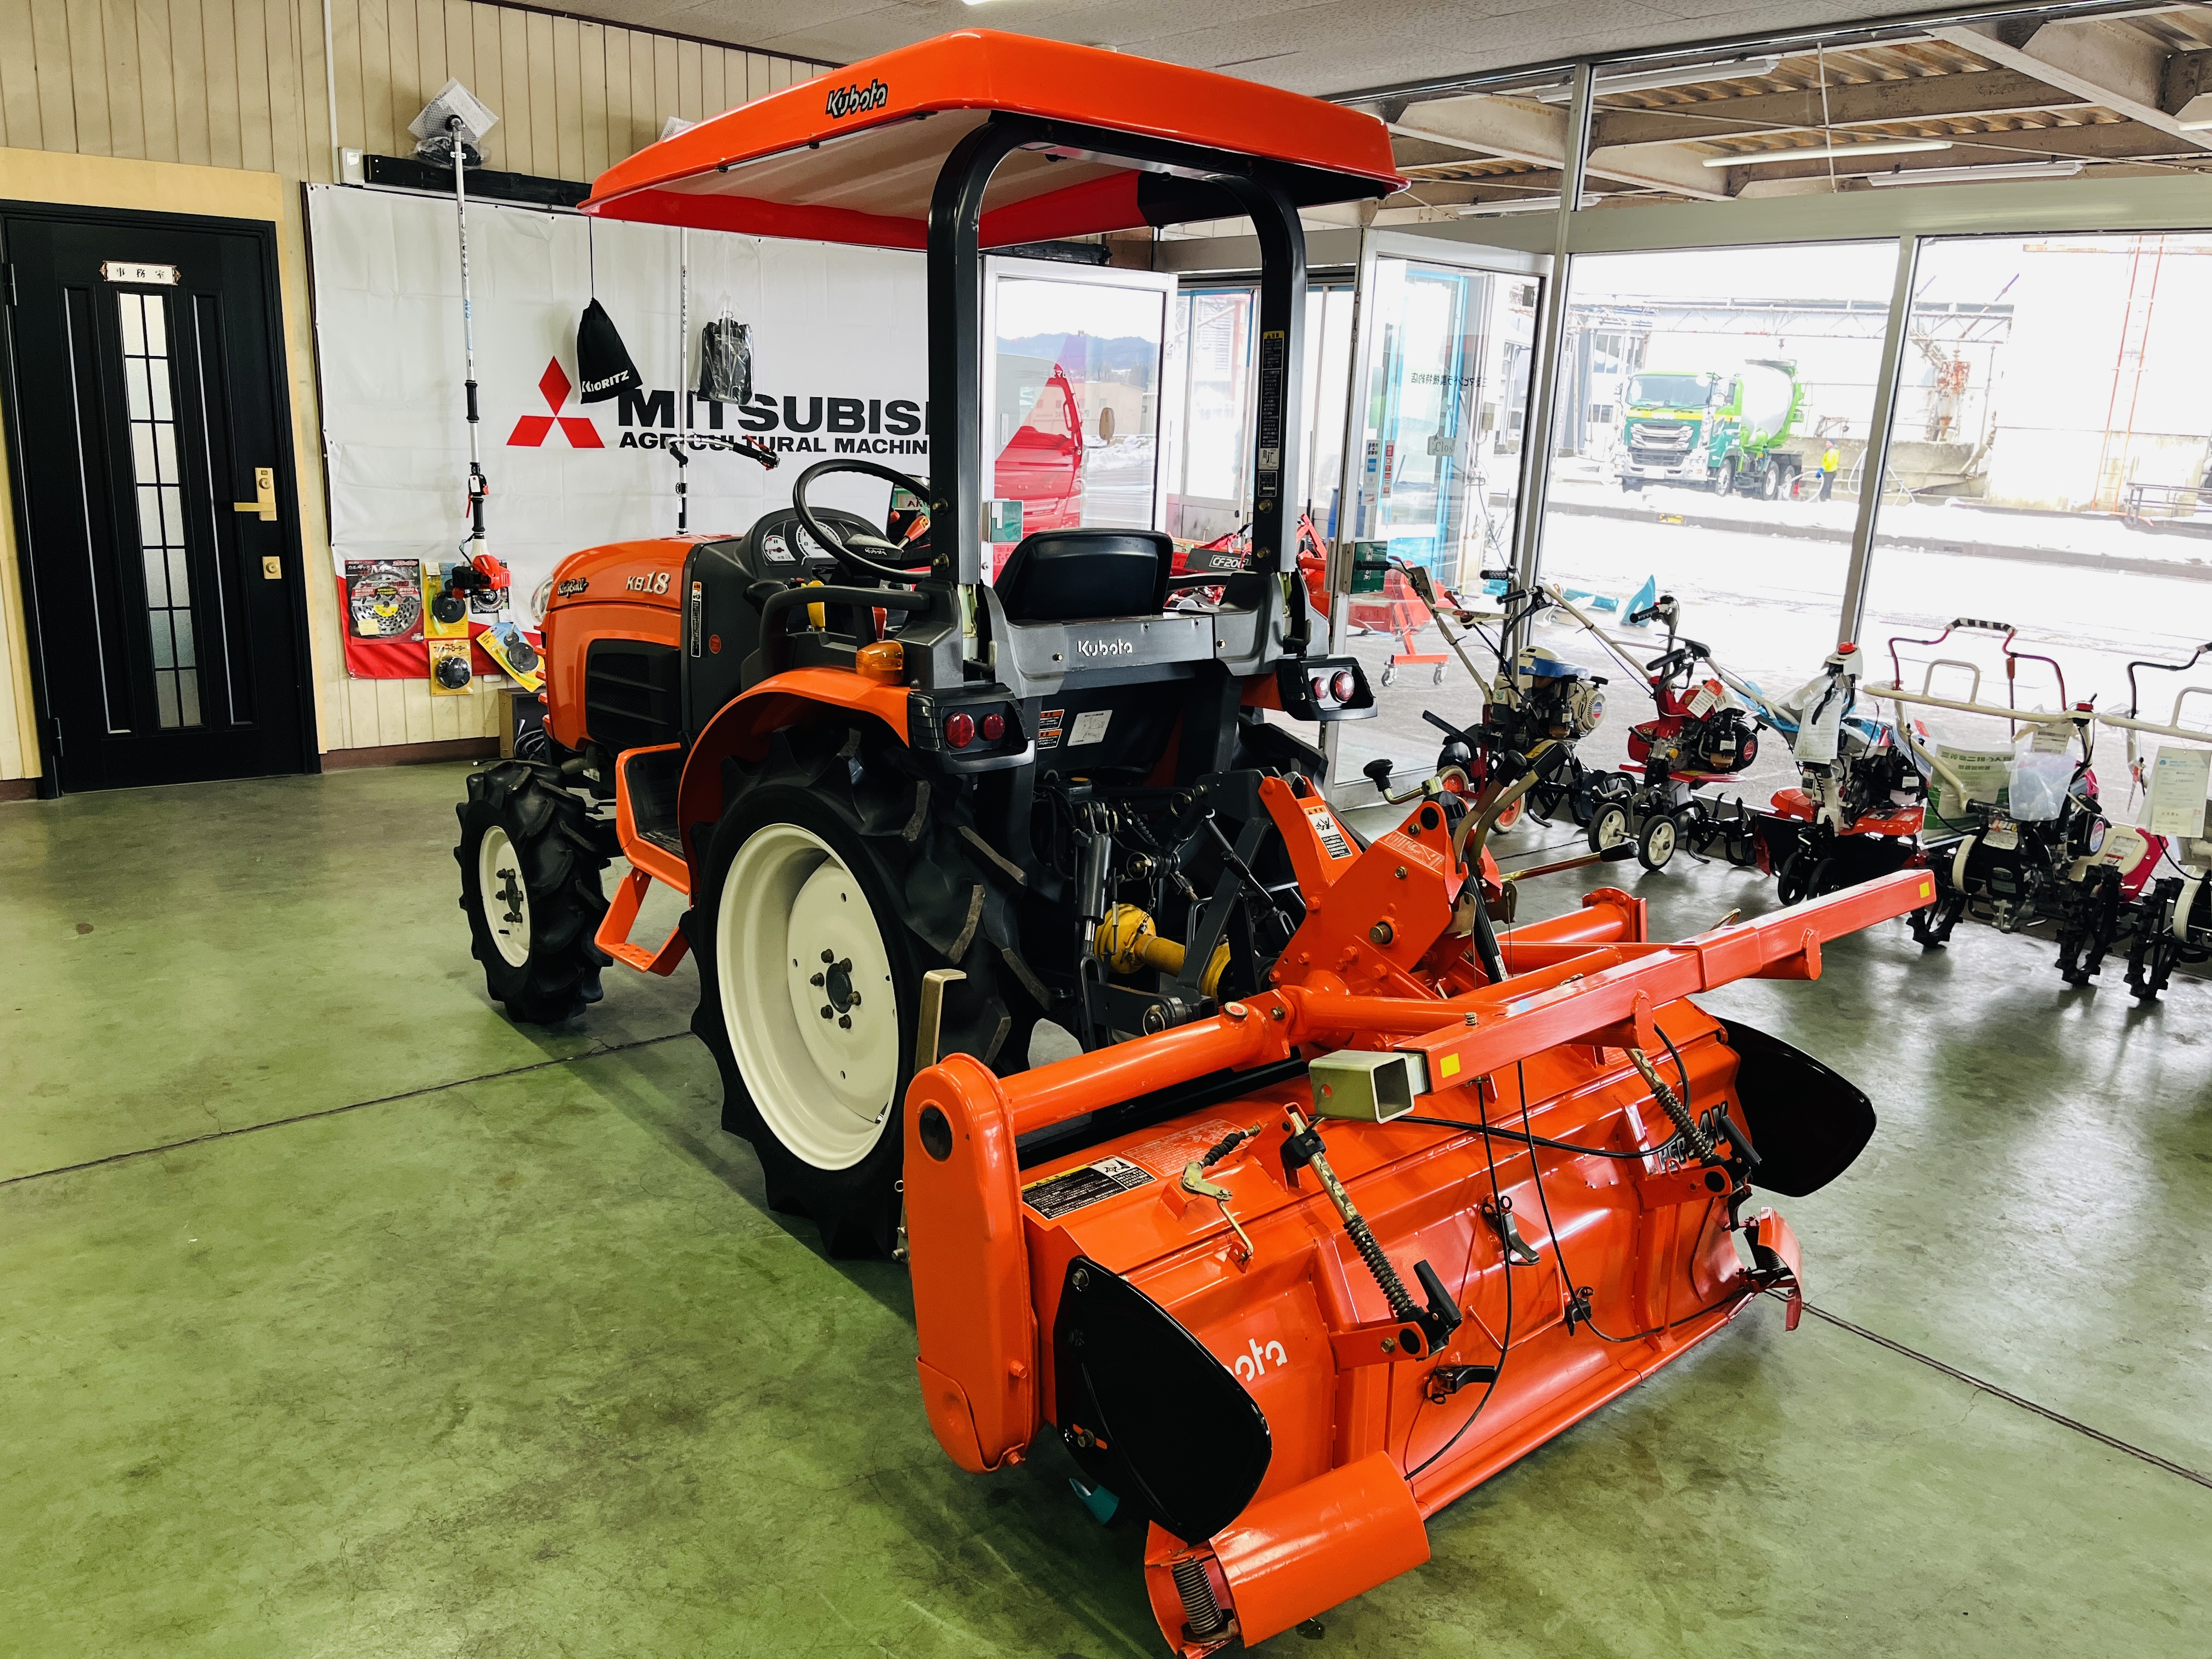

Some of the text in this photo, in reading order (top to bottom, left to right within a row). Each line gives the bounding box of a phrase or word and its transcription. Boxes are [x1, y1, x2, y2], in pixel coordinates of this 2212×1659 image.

[826, 80, 888, 119] Kubota
[582, 370, 630, 393] KIORITZ
[617, 388, 929, 437] MITSUBIS
[619, 431, 827, 454] AGRCUTURAL
[625, 571, 670, 595] KB18
[1077, 639, 1133, 657] Kubota
[1223, 1338, 1288, 1383] ota
